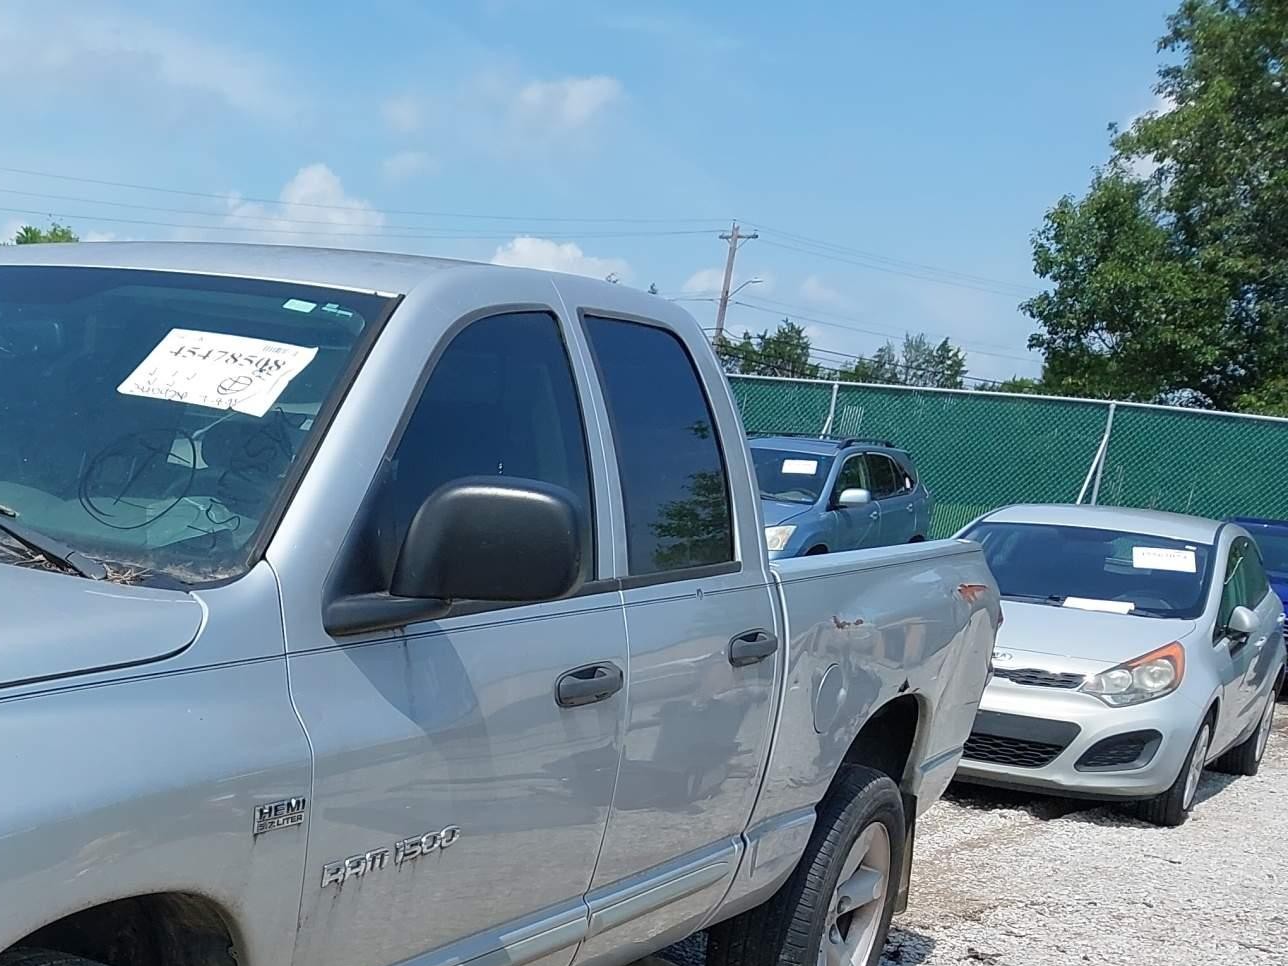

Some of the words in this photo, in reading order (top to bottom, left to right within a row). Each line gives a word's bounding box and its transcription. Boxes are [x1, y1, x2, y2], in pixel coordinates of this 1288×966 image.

[170, 345, 286, 372] 45478508
[259, 799, 306, 820] HEMI
[277, 814, 303, 826] LITER
[321, 847, 389, 889] RAM
[395, 824, 461, 865] 1500
